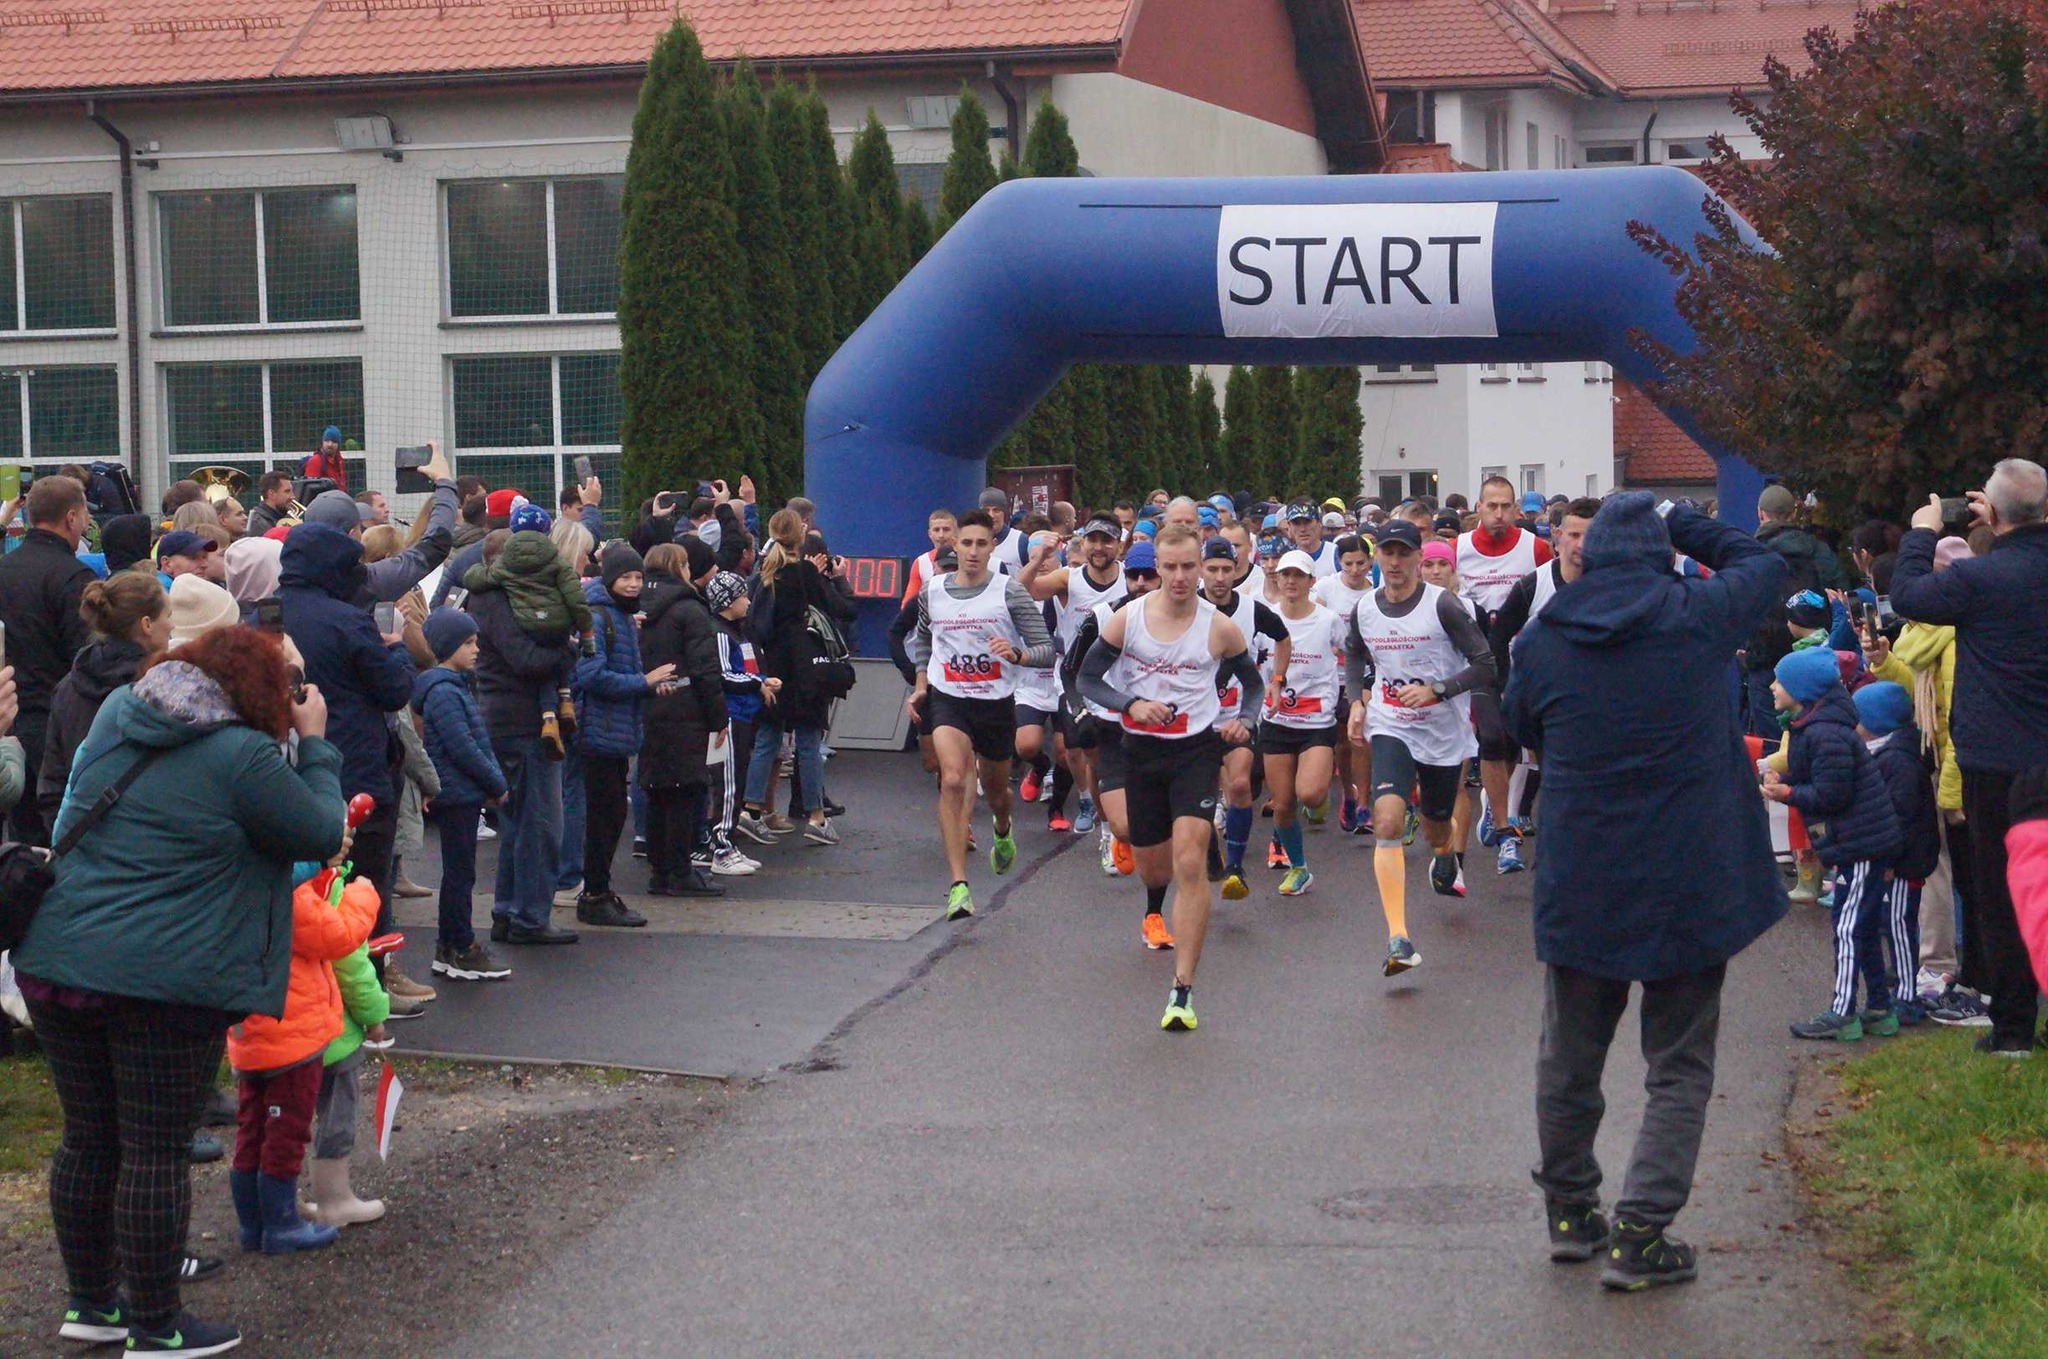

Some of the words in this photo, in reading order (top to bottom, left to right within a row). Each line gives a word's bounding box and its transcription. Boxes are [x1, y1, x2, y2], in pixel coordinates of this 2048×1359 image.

[1229, 236, 1481, 305] START
[949, 653, 991, 675] 486
[1284, 688, 1297, 707] 3
